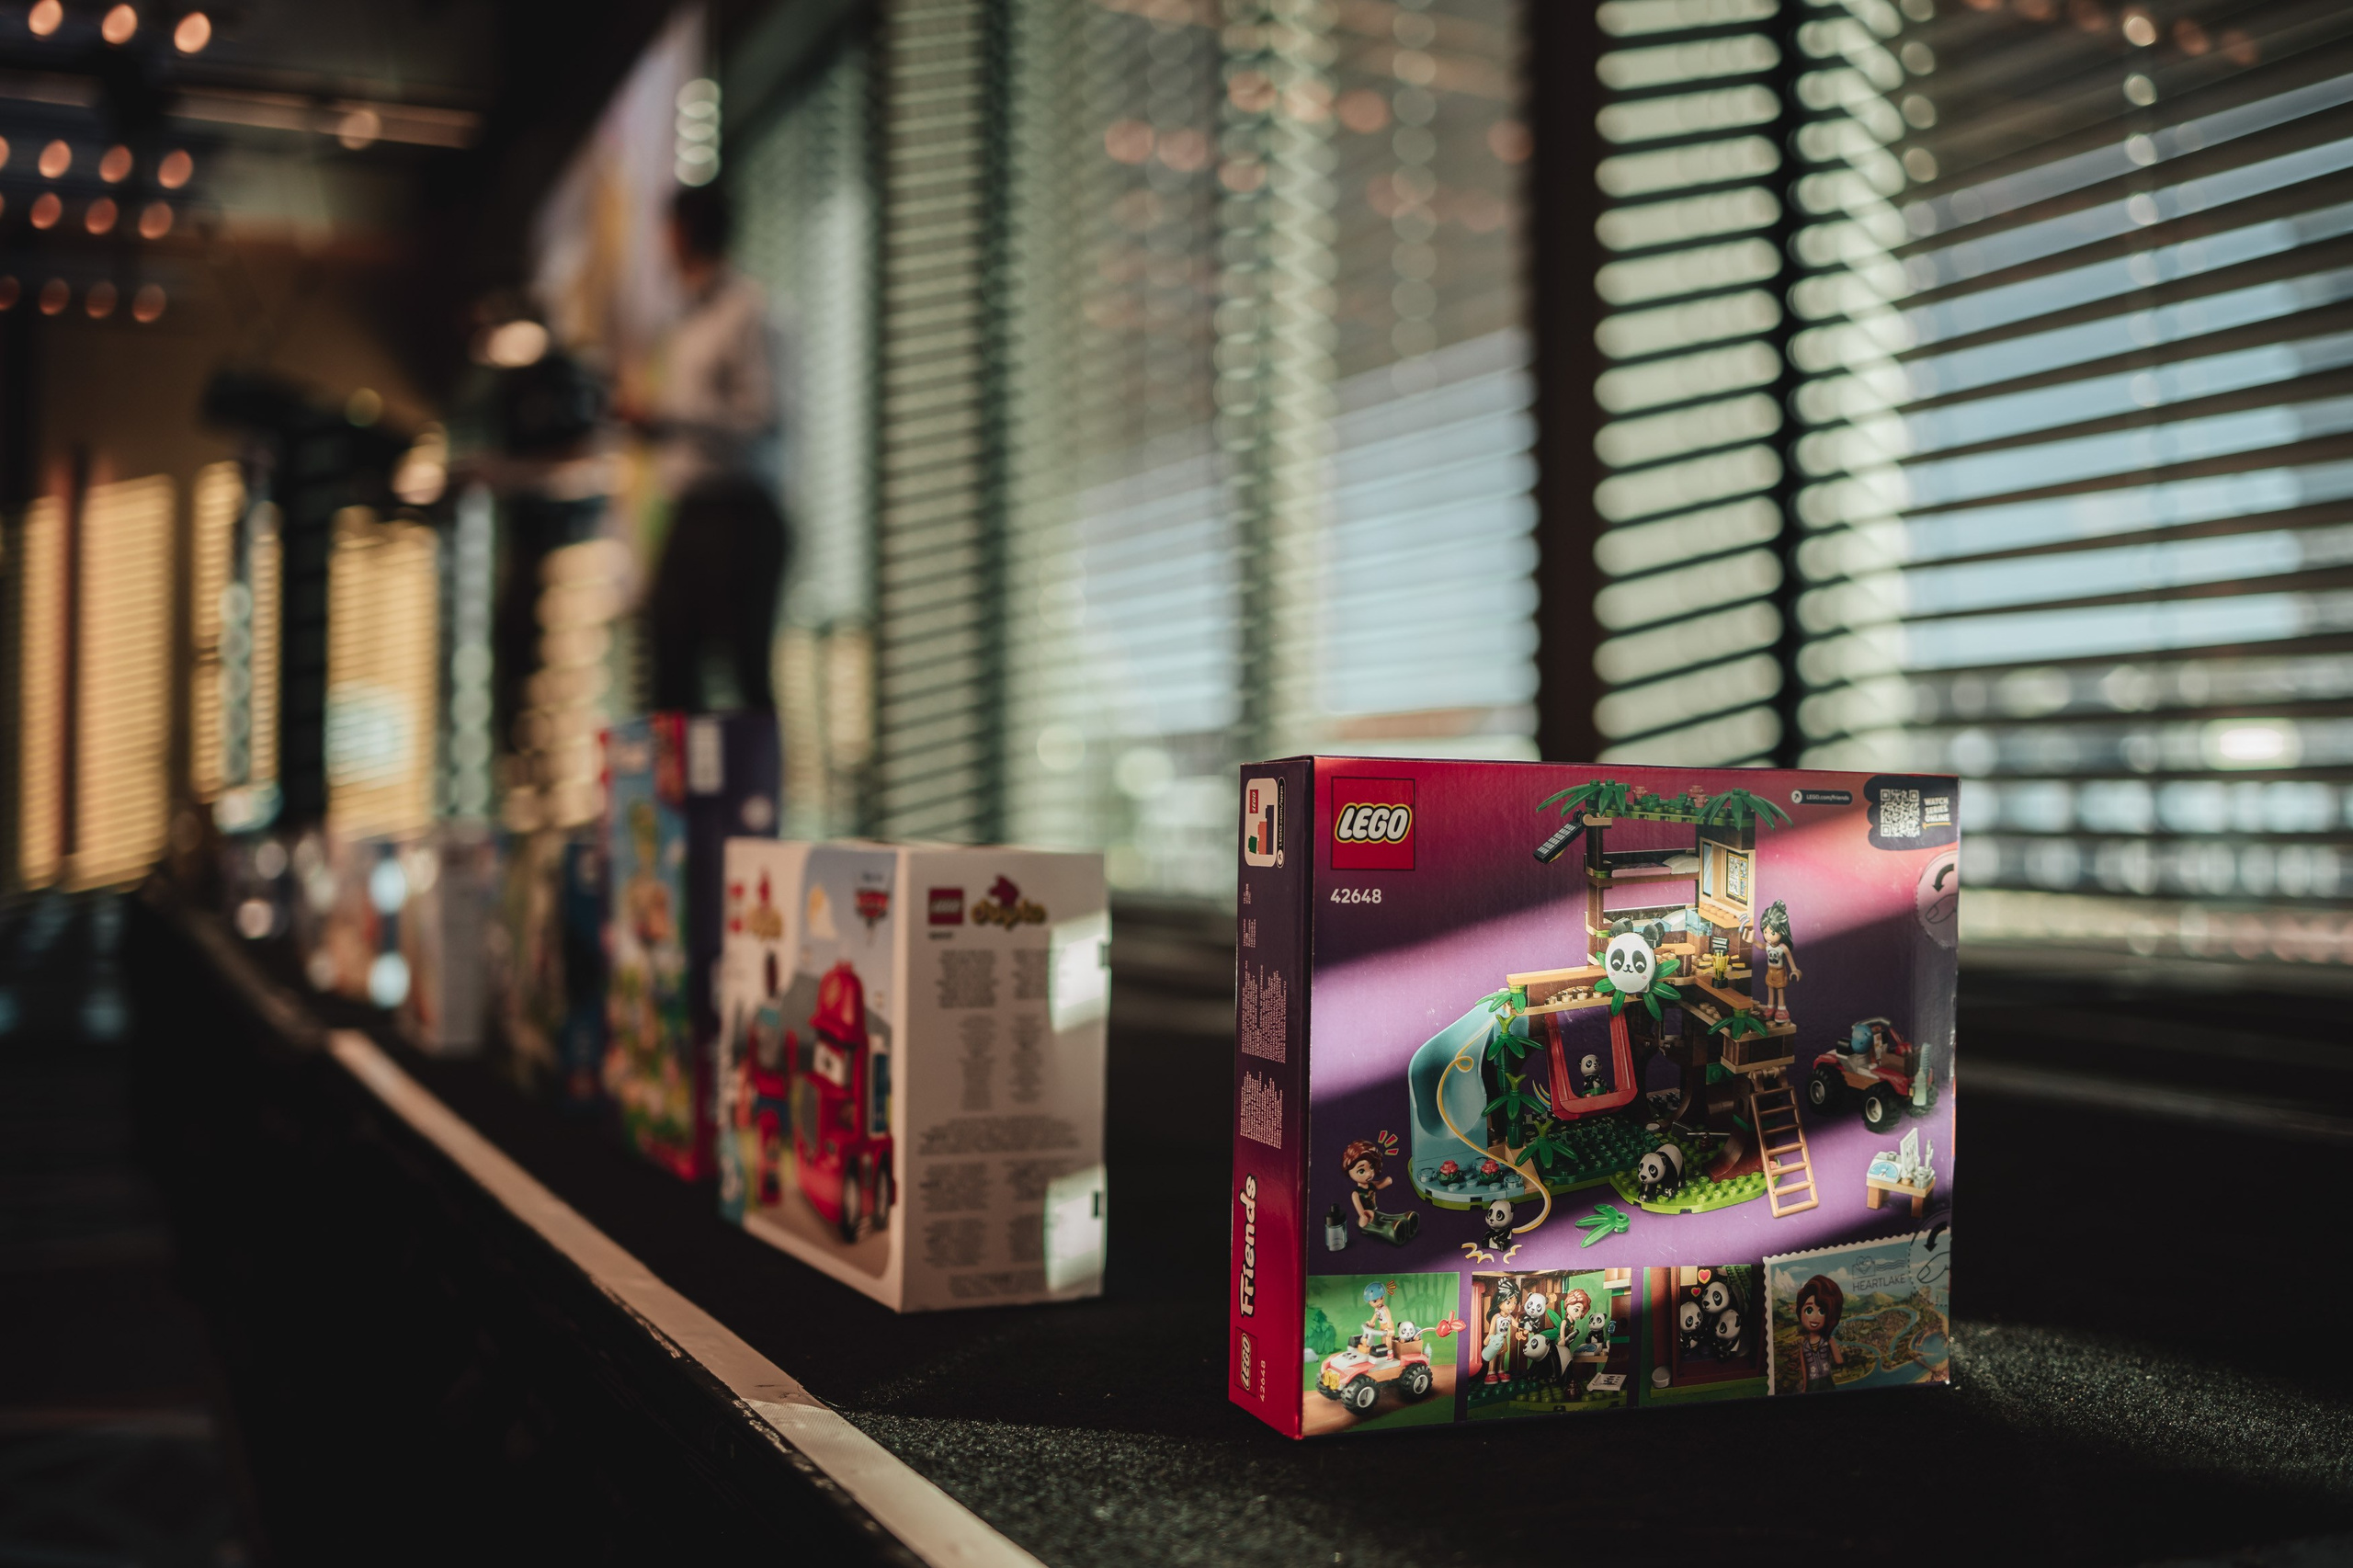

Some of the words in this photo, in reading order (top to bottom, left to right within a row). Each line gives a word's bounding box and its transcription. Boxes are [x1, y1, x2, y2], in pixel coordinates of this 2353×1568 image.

[1806, 793, 1850, 802] LEGO.com/friends
[1923, 796, 1949, 806] WATCH
[1925, 804, 1949, 813] SERIES
[1336, 803, 1411, 843] LEGO
[1925, 812, 1950, 823] ONLINE
[1330, 888, 1381, 903] 42648
[1239, 1174, 1256, 1317] Friends
[1852, 1274, 1905, 1291] HEARTLAKE
[1241, 1333, 1251, 1391] LEGO
